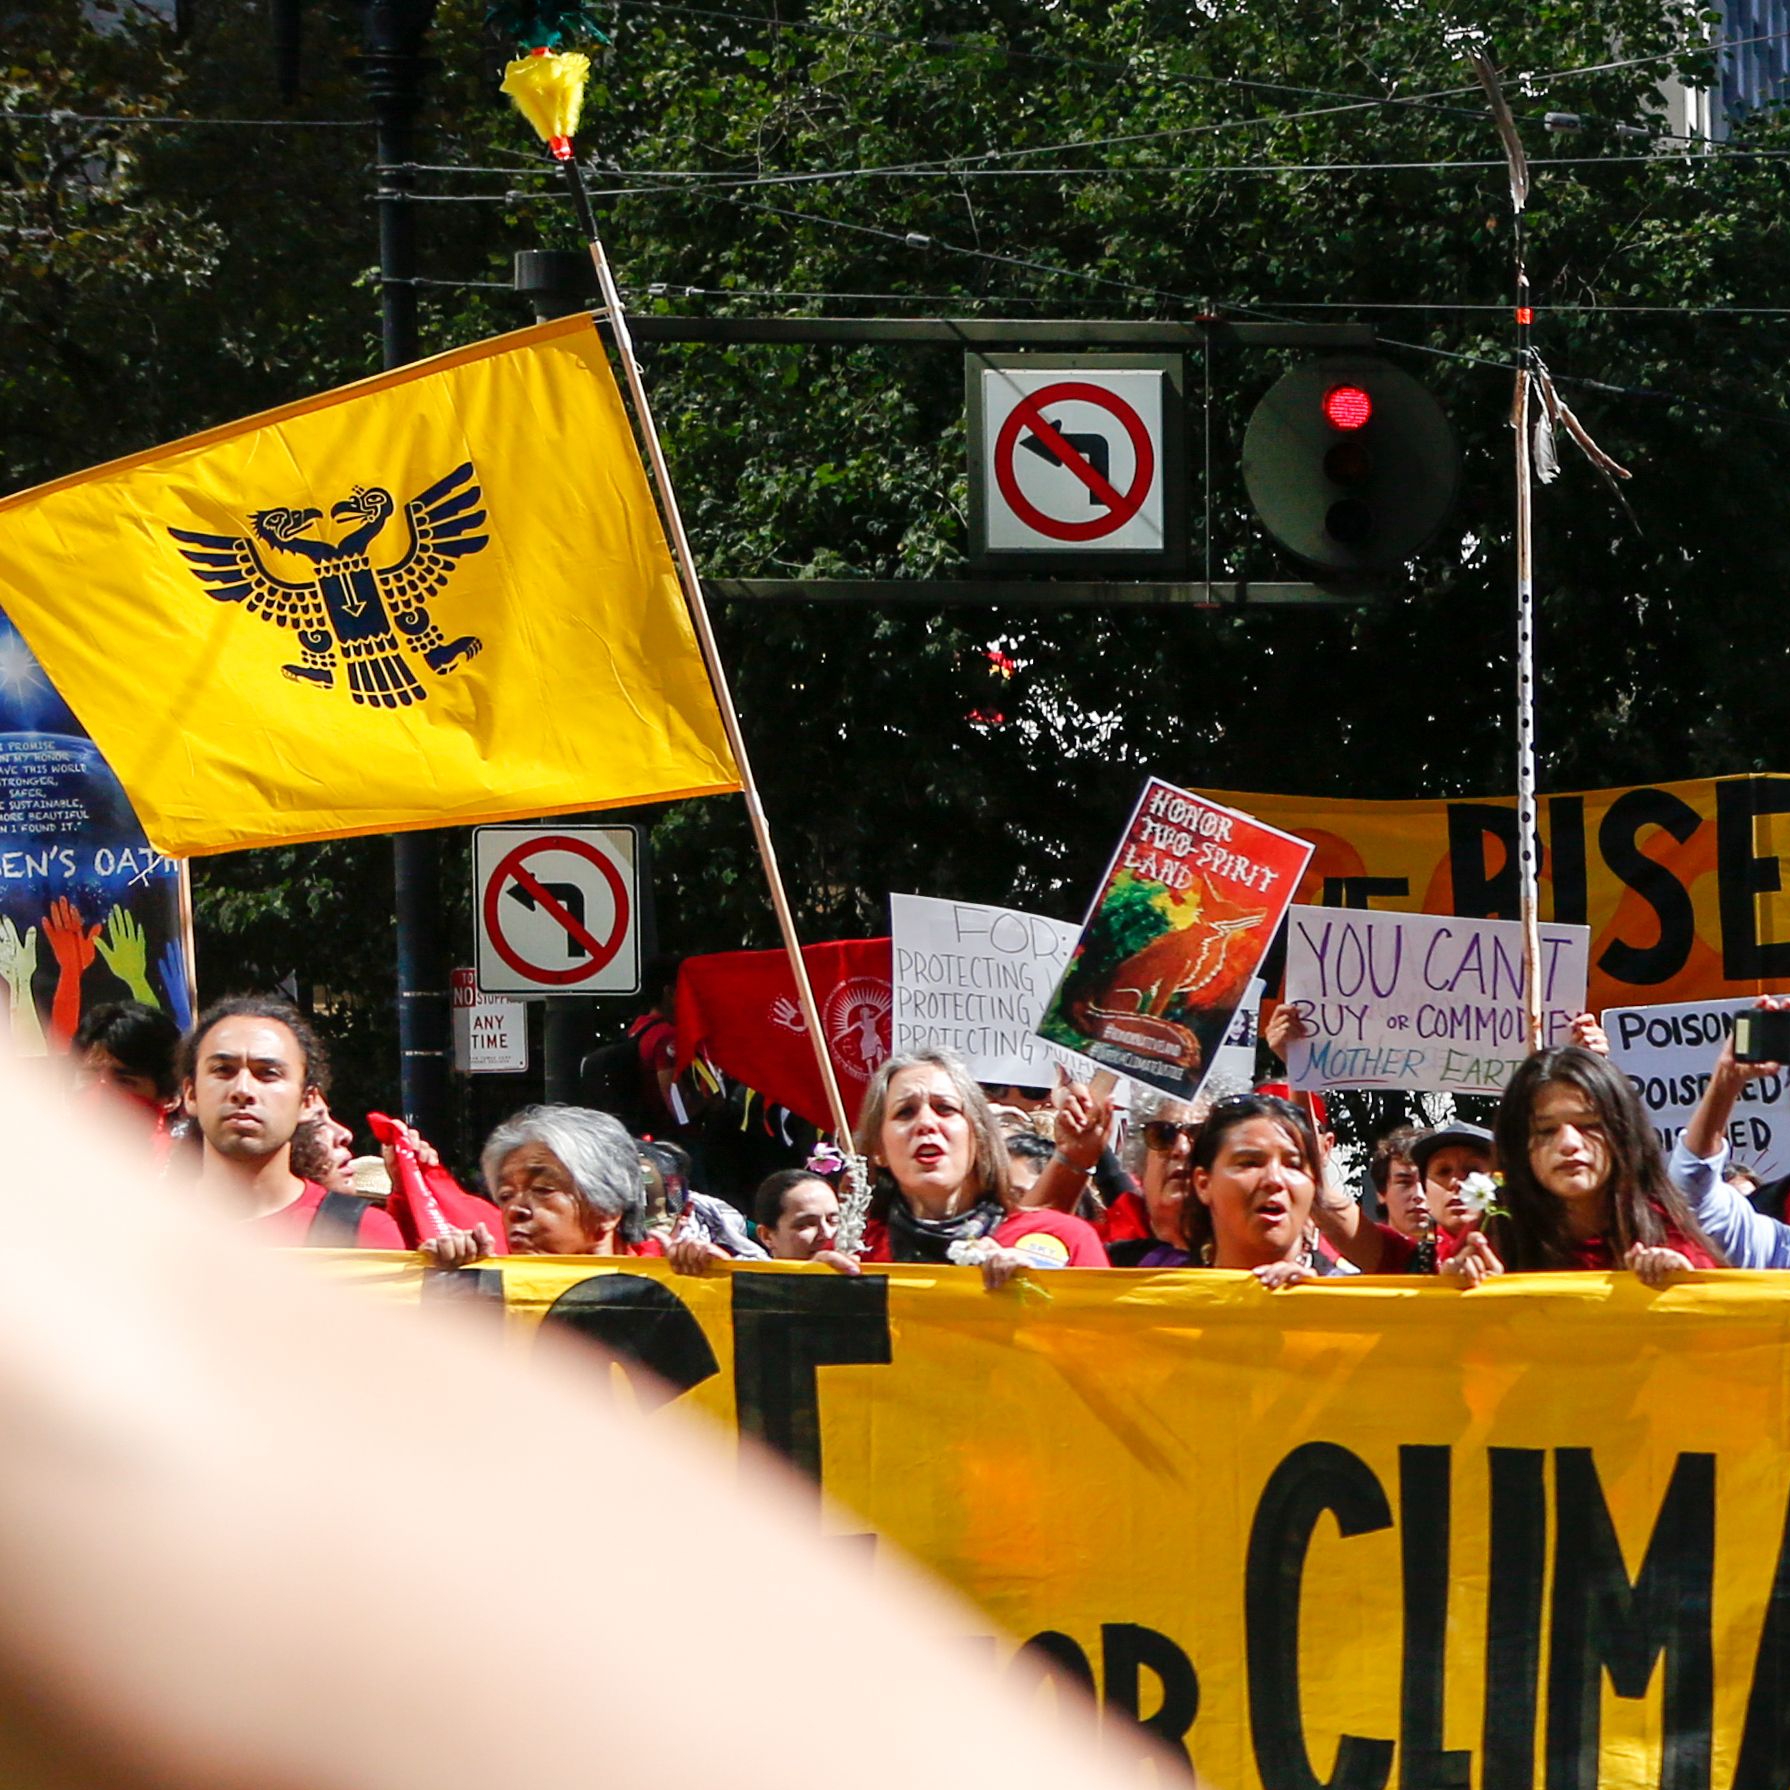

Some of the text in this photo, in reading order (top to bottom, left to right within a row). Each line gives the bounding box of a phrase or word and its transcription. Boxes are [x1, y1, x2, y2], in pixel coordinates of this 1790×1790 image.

[8, 741, 55, 751] PROMISE
[23, 765, 48, 774] THIS
[52, 763, 87, 774] WORLD
[21, 822, 56, 833] FOUND
[28, 810, 90, 821] BEAUTIFUL
[1150, 789, 1234, 842] HONOR
[0, 845, 76, 879] EN'S
[1123, 844, 1194, 890] LAND
[897, 948, 1034, 997] PROTECTING
[1297, 921, 1403, 998] YOU
[454, 986, 474, 1006] NO
[897, 986, 1031, 1027] PROTECTING
[473, 1014, 505, 1031] ANY
[1293, 999, 1369, 1041] BUY
[471, 1033, 508, 1049] TIME
[1295, 1041, 1526, 1086] MOTHER EART
